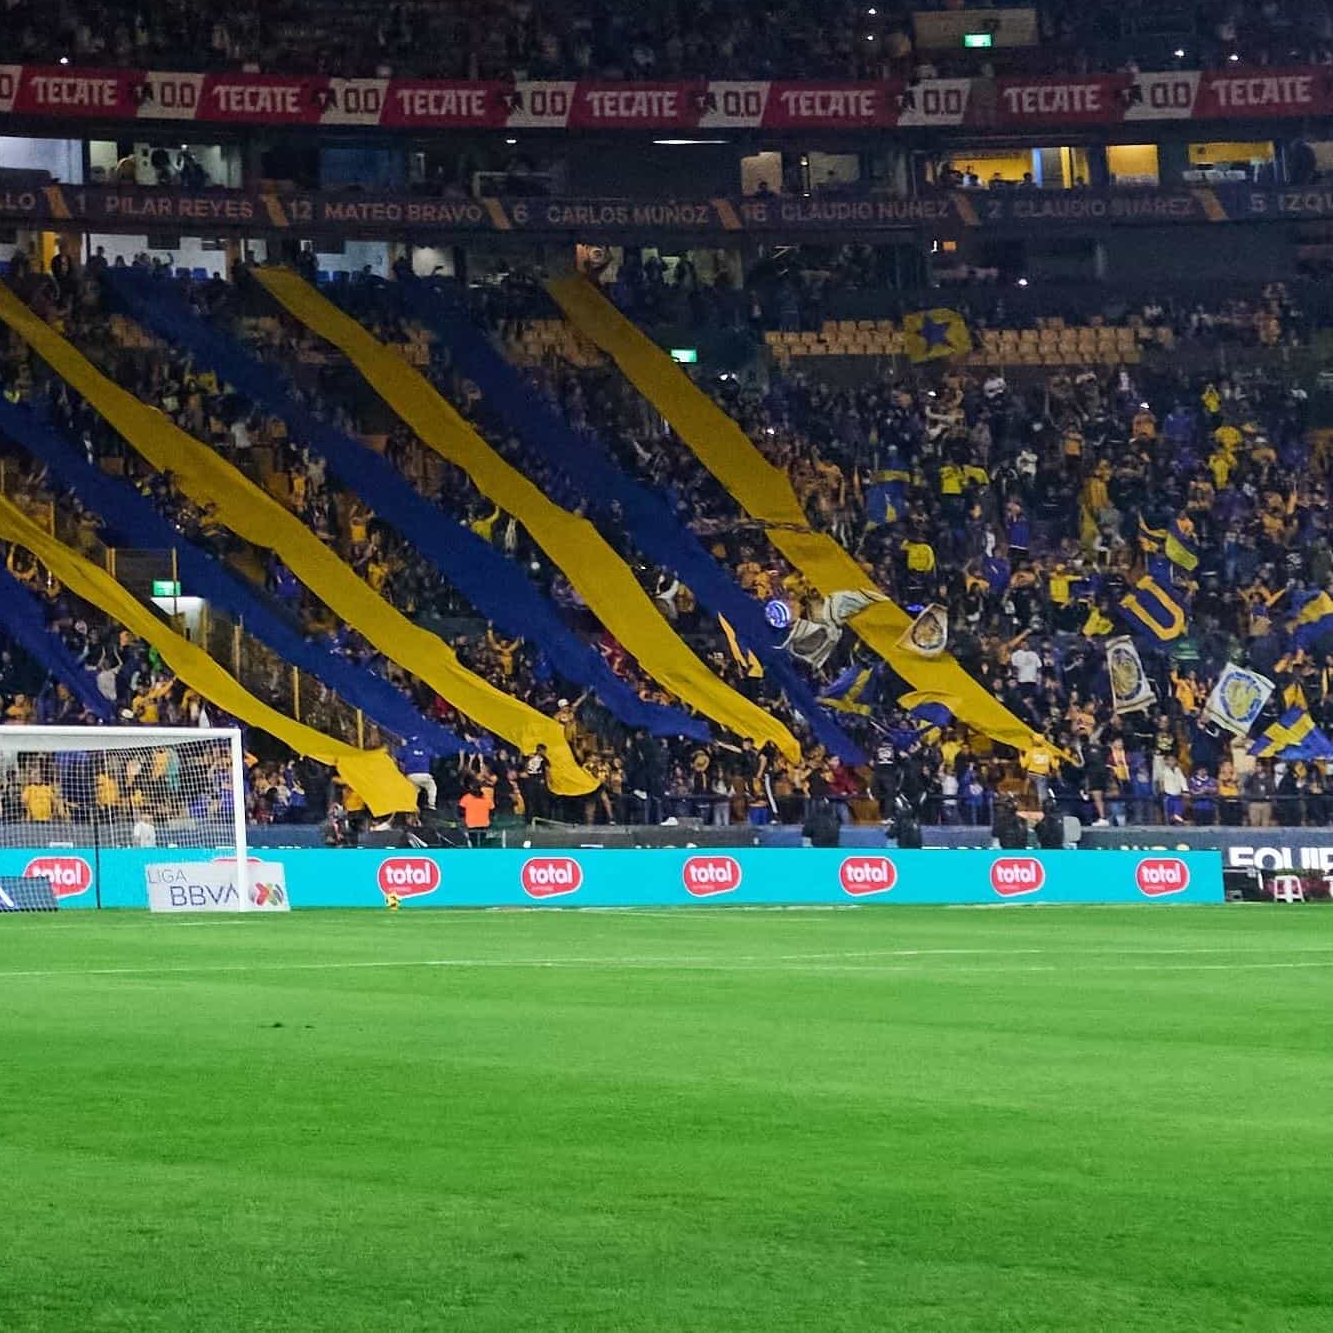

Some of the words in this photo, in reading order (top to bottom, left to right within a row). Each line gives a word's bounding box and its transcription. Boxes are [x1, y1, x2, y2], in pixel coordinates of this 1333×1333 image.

[29, 77, 118, 106] TECATE
[212, 86, 302, 114] TECATE
[395, 89, 488, 116] TECATE
[1003, 84, 1102, 113] TECATE
[1210, 76, 1313, 106] TECATE
[585, 90, 677, 118] TECATE
[780, 90, 876, 116] TECATE
[179, 198, 253, 220] REYES
[147, 869, 187, 884] LIGA
[385, 862, 431, 885] total
[528, 862, 573, 884] total
[689, 862, 732, 884] total
[845, 862, 888, 883] total
[996, 863, 1036, 884] total
[1142, 863, 1181, 884] total
